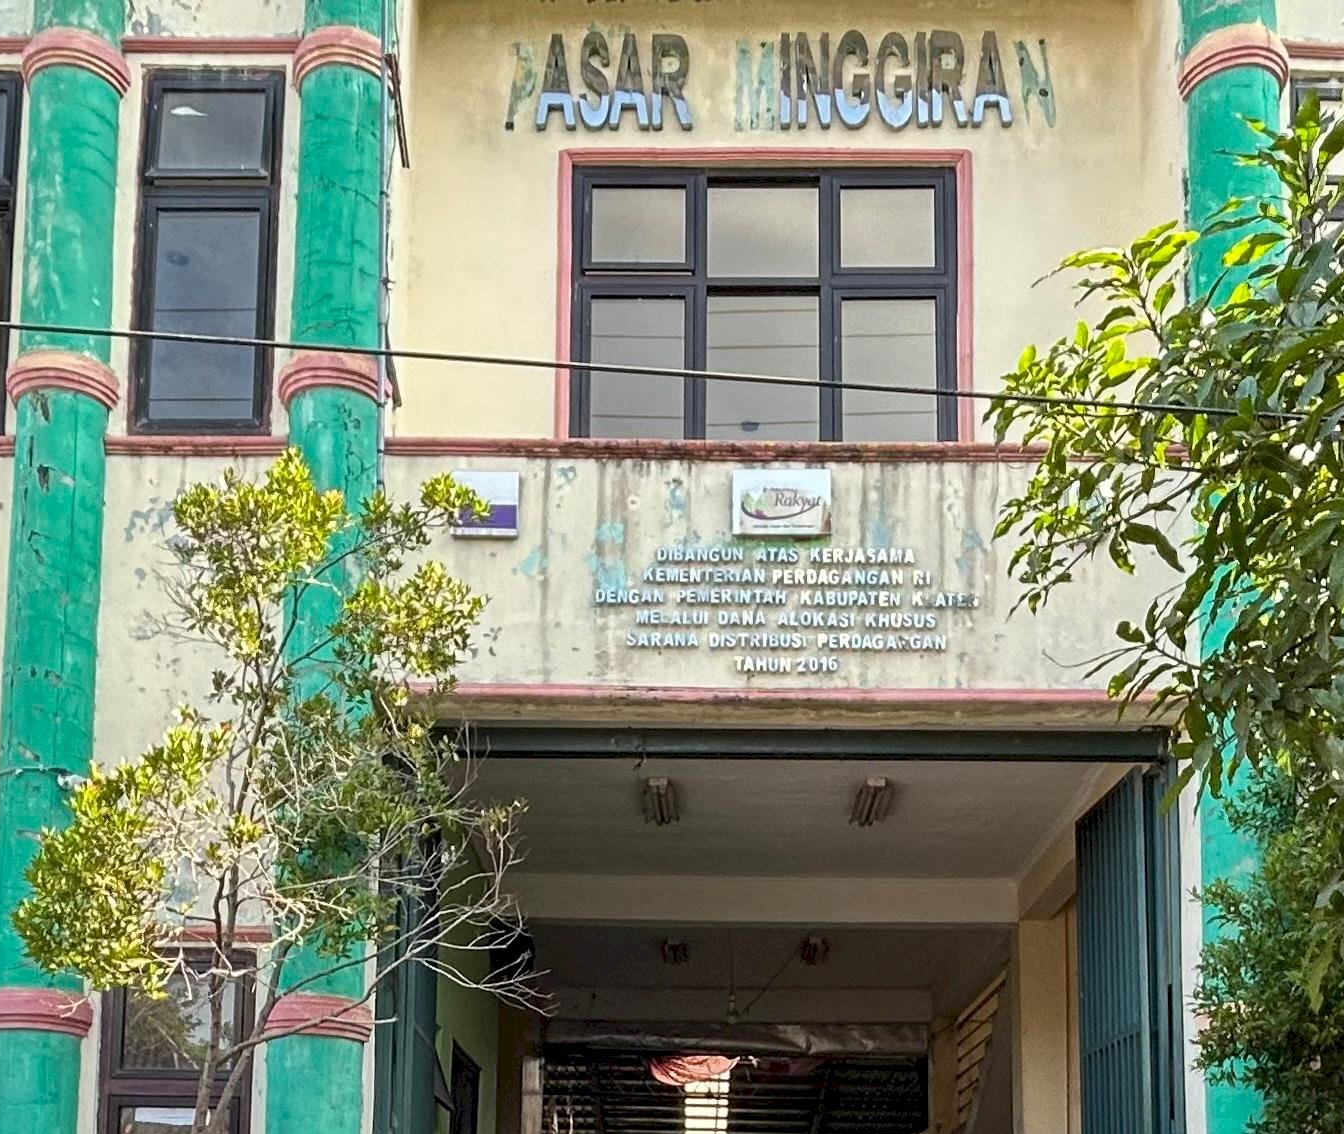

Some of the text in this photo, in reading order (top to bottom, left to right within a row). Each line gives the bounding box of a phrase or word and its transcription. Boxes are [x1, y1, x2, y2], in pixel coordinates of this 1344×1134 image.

[505, 30, 1055, 132] PASAR MINGGIRAN
[656, 547, 916, 564] DIBANGUN ATAS KERJASAMA
[642, 567, 932, 585] KEMENTERIAN PERDAGANGAN RI
[594, 589, 980, 608] DENGAN PEMERINTAH KABUPATEN KATEN
[718, 611, 767, 626] DANA
[777, 612, 855, 628] ALOKASI
[865, 613, 937, 629] KHUSUS
[626, 631, 699, 647] SARANA
[709, 632, 807, 649] DISTRIBUSI
[734, 656, 838, 672] TAHUN 2016
